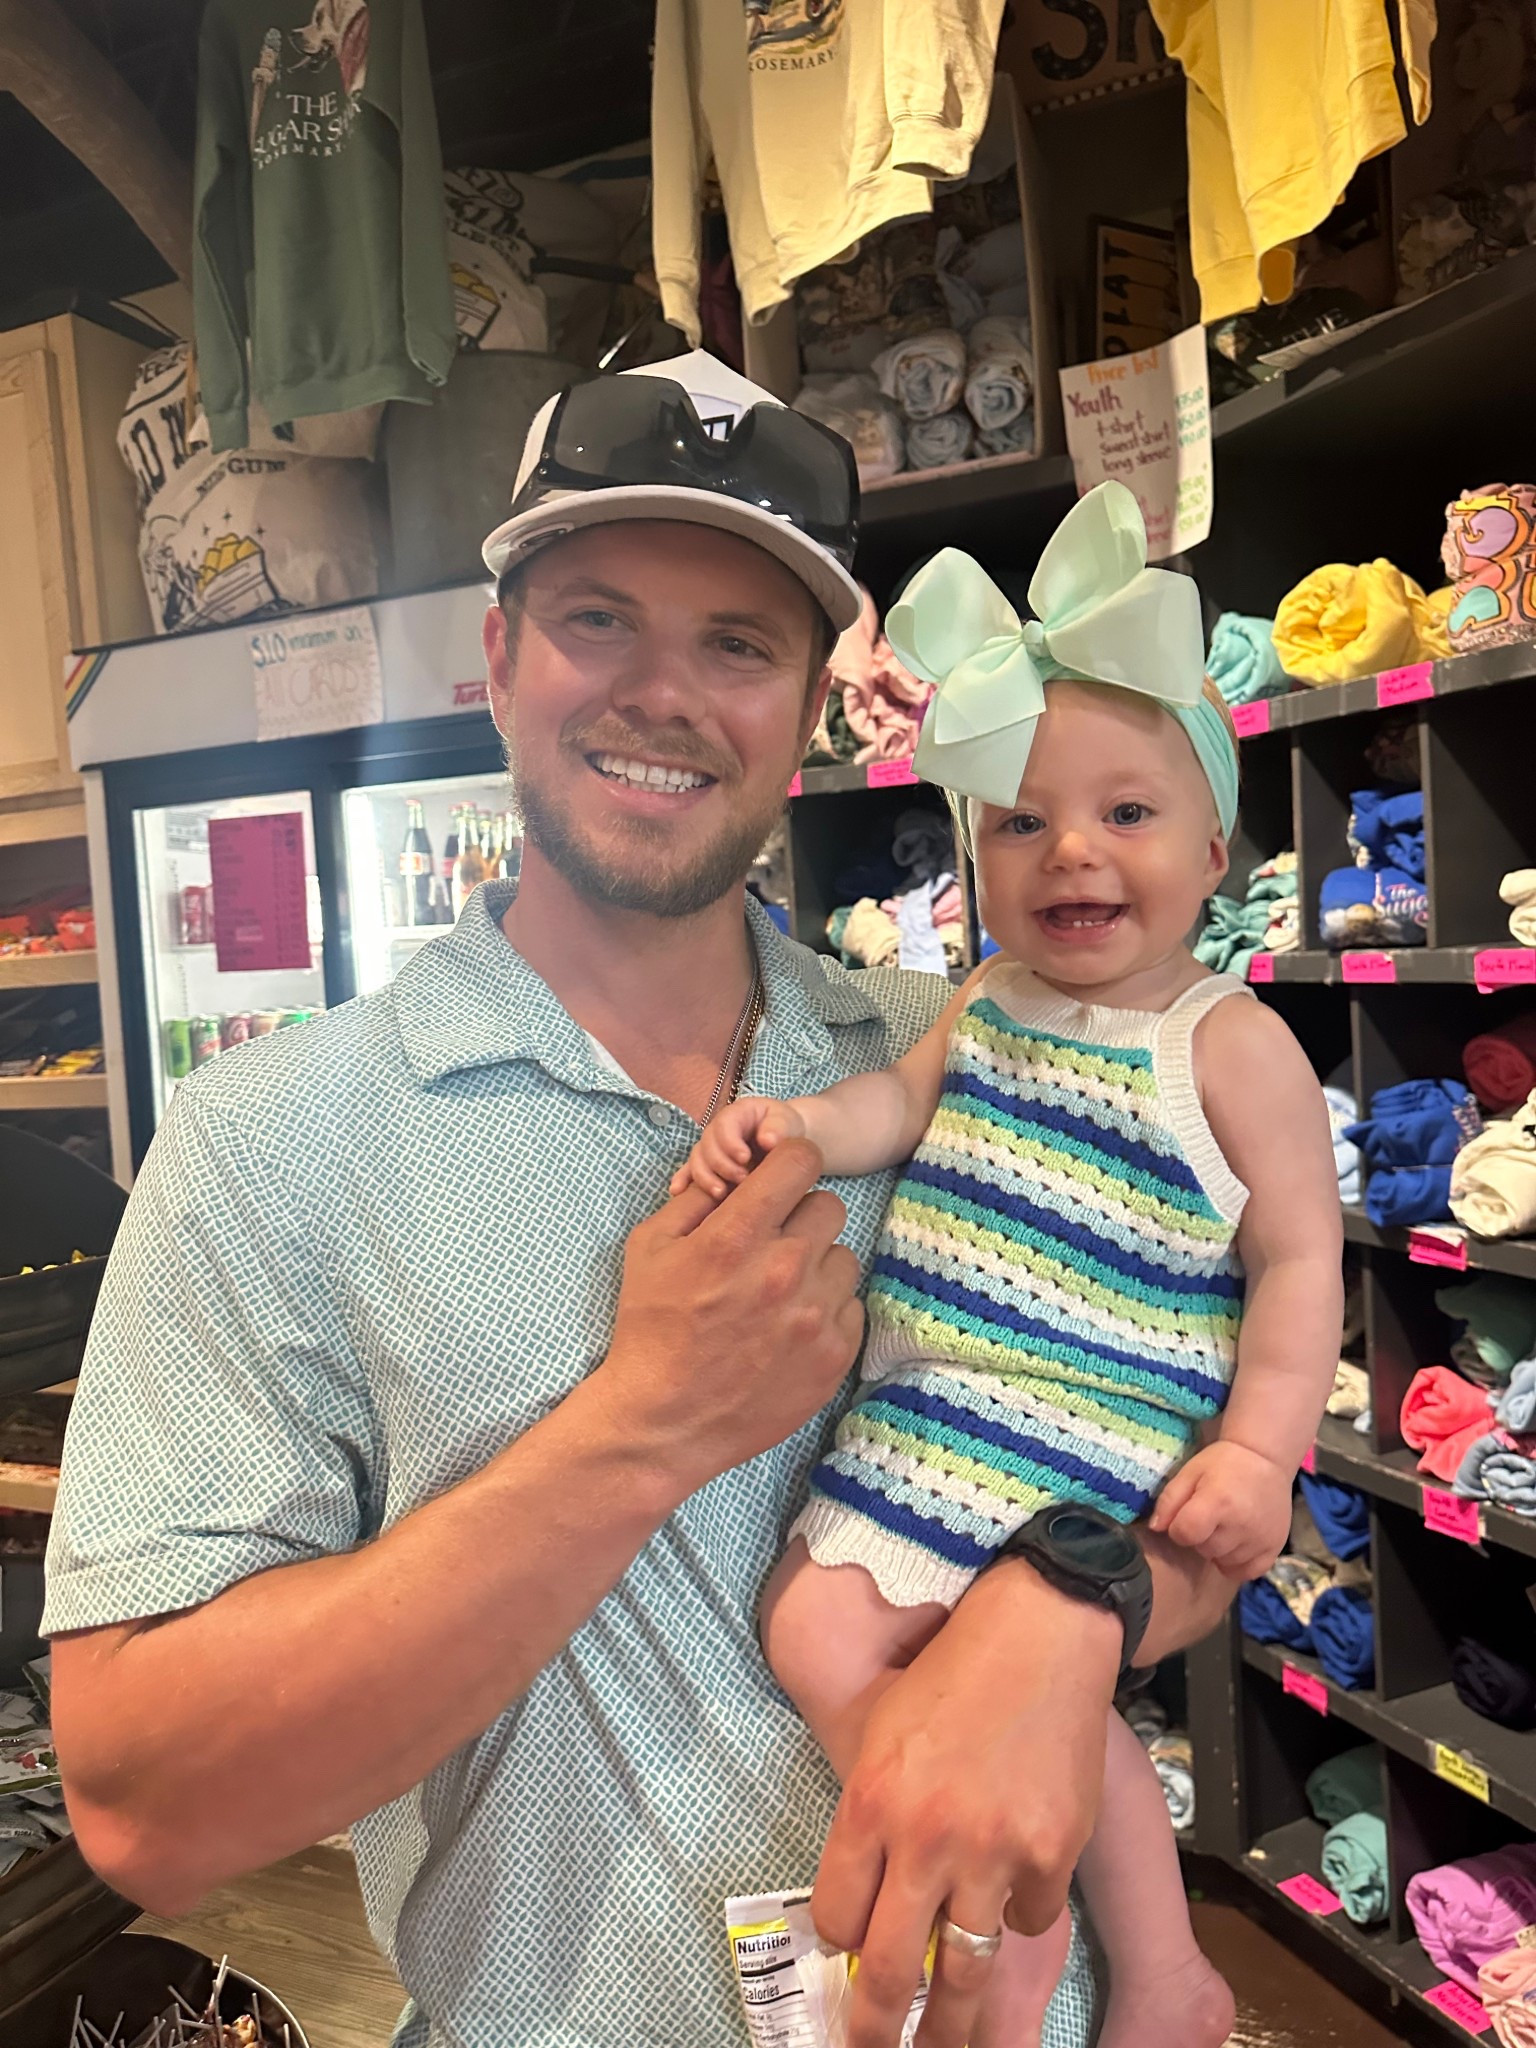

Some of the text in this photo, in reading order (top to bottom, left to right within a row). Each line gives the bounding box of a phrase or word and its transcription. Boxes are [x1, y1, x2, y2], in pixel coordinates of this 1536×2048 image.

[285, 91, 338, 117] THE
[1067, 385, 1122, 418] Youth
[227, 457, 286, 475] GUM
[1102, 457, 1134, 475] long
[252, 631, 287, 668] $10
[453, 680, 489, 705] Turb
[1385, 883, 1417, 901] The
